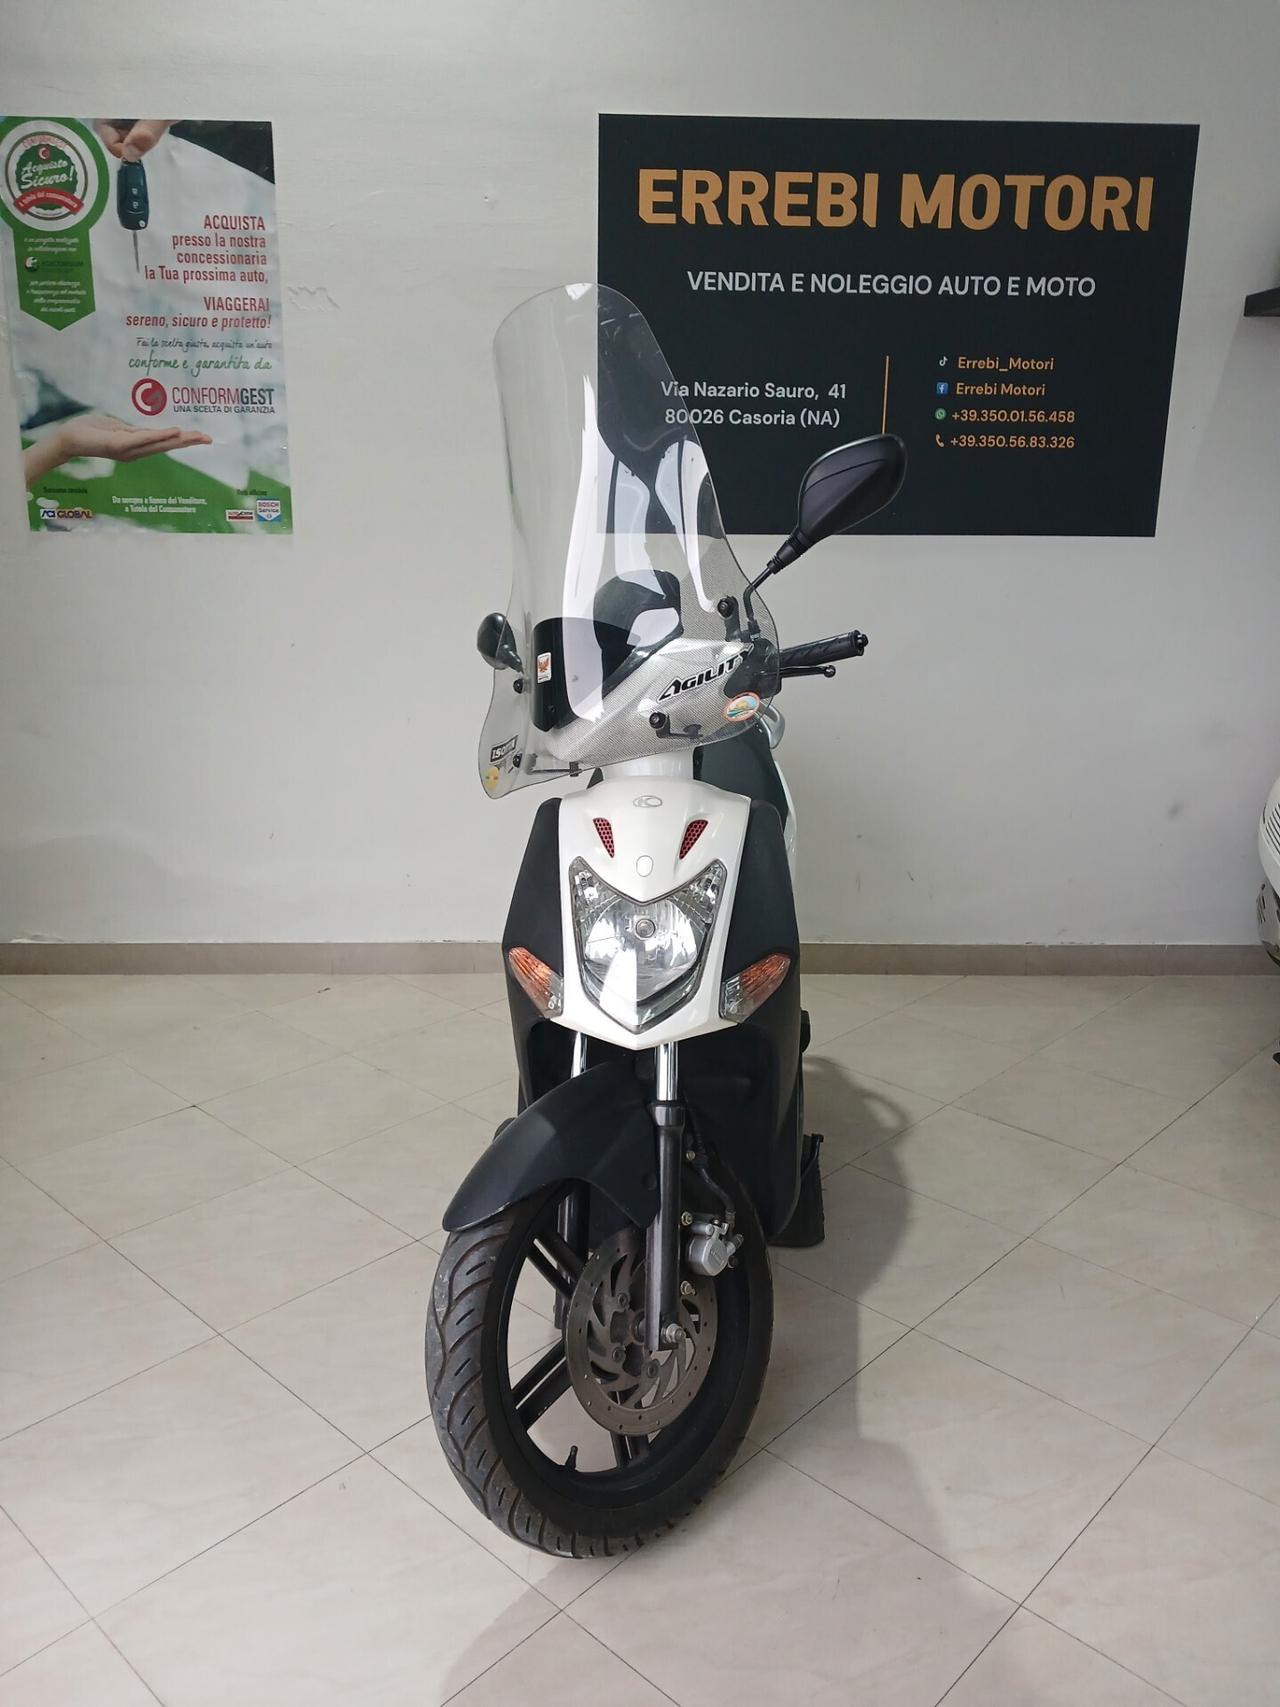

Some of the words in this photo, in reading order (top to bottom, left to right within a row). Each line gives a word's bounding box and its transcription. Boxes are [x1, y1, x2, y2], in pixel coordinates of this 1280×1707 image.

[21, 159, 69, 175] Acquisto
[20, 166, 75, 190] Sicuro!
[638, 168, 879, 228] ERREBI
[900, 173, 1154, 231] MOTORI
[204, 215, 266, 231] ACQUISTA
[172, 234, 211, 249] presso
[215, 233, 226, 247] la
[229, 235, 266, 248] nostra
[177, 250, 267, 265] concessionaria
[145, 265, 156, 280] la
[159, 266, 179, 280] Tua
[183, 267, 236, 284] prossima
[240, 270, 268, 284] auto,
[687, 270, 785, 292] VENDITA
[791, 273, 805, 293] E
[810, 273, 932, 295] NOLEGGIO
[938, 275, 1001, 296] AUTO
[1007, 276, 1021, 296] E
[1026, 276, 1096, 297] MOTO
[204, 297, 270, 312] VIAGGERAI
[126, 315, 168, 329] sereno,
[172, 313, 208, 327] sicuro
[211, 317, 218, 327] e
[221, 314, 272, 331] protetto!
[129, 349, 179, 376] conforme
[182, 360, 190, 370] e
[191, 355, 250, 378] garantita
[254, 358, 273, 370] da
[958, 356, 1055, 373] Errebi_Motori
[172, 387, 275, 406] CONFORMGEST
[661, 381, 689, 397] Via
[695, 381, 760, 398] Nazario
[765, 382, 819, 401] Sauro,
[828, 383, 847, 399] 41
[956, 382, 997, 396] Errebi
[1001, 383, 1046, 397] Motori
[194, 406, 222, 414] SCELTA
[224, 406, 233, 414] DI
[234, 407, 275, 415] GARANZIA
[665, 407, 724, 425] 80026
[729, 408, 795, 425] Casoria
[800, 408, 840, 428] (NA)
[952, 409, 1076, 424] +39.350.01.56.458
[950, 434, 1076, 449] +39.350.56.83.326
[656, 642, 755, 703] AGILITY
